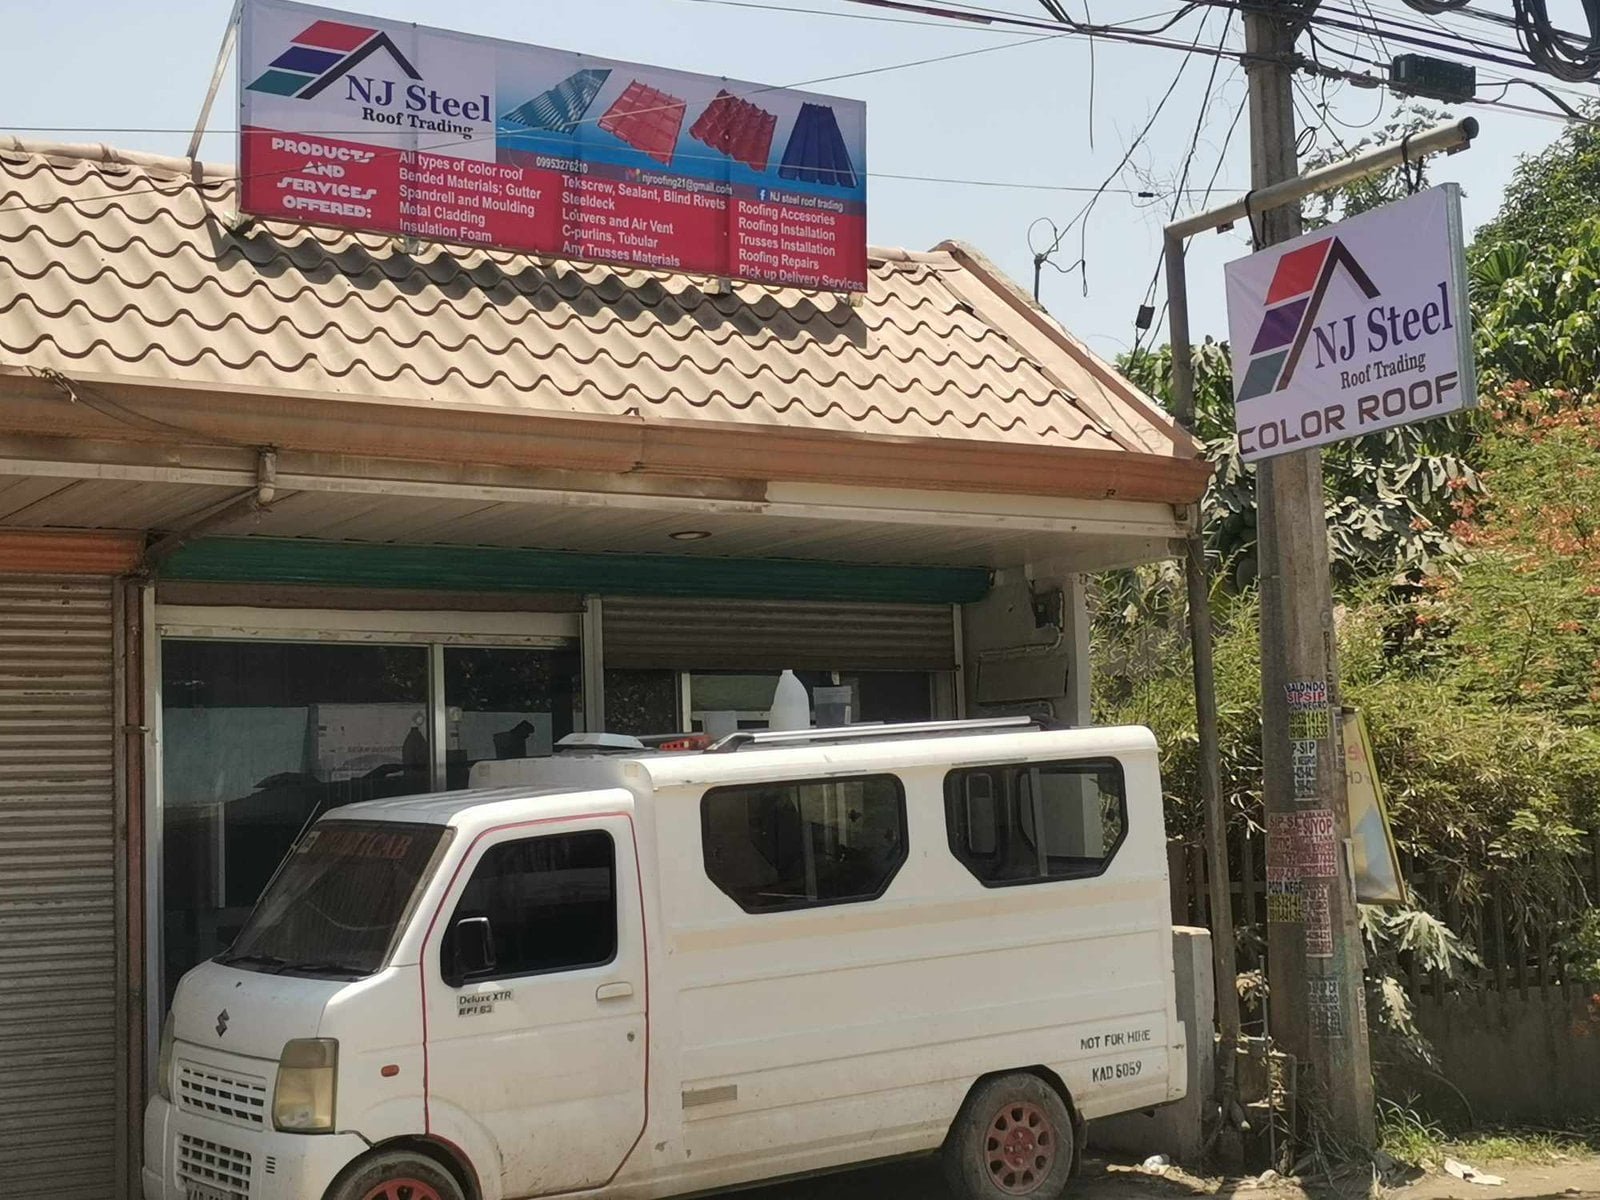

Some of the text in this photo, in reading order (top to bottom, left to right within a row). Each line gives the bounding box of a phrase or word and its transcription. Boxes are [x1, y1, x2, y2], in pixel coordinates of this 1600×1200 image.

[345, 74, 492, 123] NJ Steel
[362, 107, 474, 140] Roof Trading
[271, 137, 375, 163] PRODUCTS
[301, 160, 345, 178] AND
[399, 151, 523, 181] All types of color roof
[536, 156, 589, 174] 09953276210
[276, 177, 377, 200] SERVICES
[399, 168, 541, 199] Bended Materials; Gutter
[561, 174, 726, 210] Tekscrew, Sealant, Blind Rivets
[642, 173, 732, 195] njroofing21@gmail.com
[282, 195, 371, 219] OFFERED:
[399, 185, 535, 218] Spandrell and Moulding
[562, 191, 615, 211] Steeldeck
[738, 201, 836, 226] Roofing Accesories
[769, 191, 844, 213] NJ steel roof trading
[400, 201, 486, 227] Metal Cladding
[562, 207, 674, 235] Louvers and Air Vent
[400, 218, 492, 242] Insulation Foam
[562, 224, 659, 248] C-purlins, Tubular
[738, 217, 836, 241] Roofing Installation
[562, 240, 681, 267] Any Trusses Materials
[738, 232, 836, 257] Trusses Installation
[738, 248, 820, 270] Roofing Repairs
[739, 263, 865, 291] Pick up Delivery Services
[1313, 281, 1453, 369] NJ Steel
[1340, 352, 1427, 389] Roof Trading
[1238, 370, 1458, 455] COLOR ROOF
[492, 990, 511, 1001] XTR
[1080, 1029, 1151, 1050] NOT FOR HIRE
[1092, 1066, 1113, 1083] KAD
